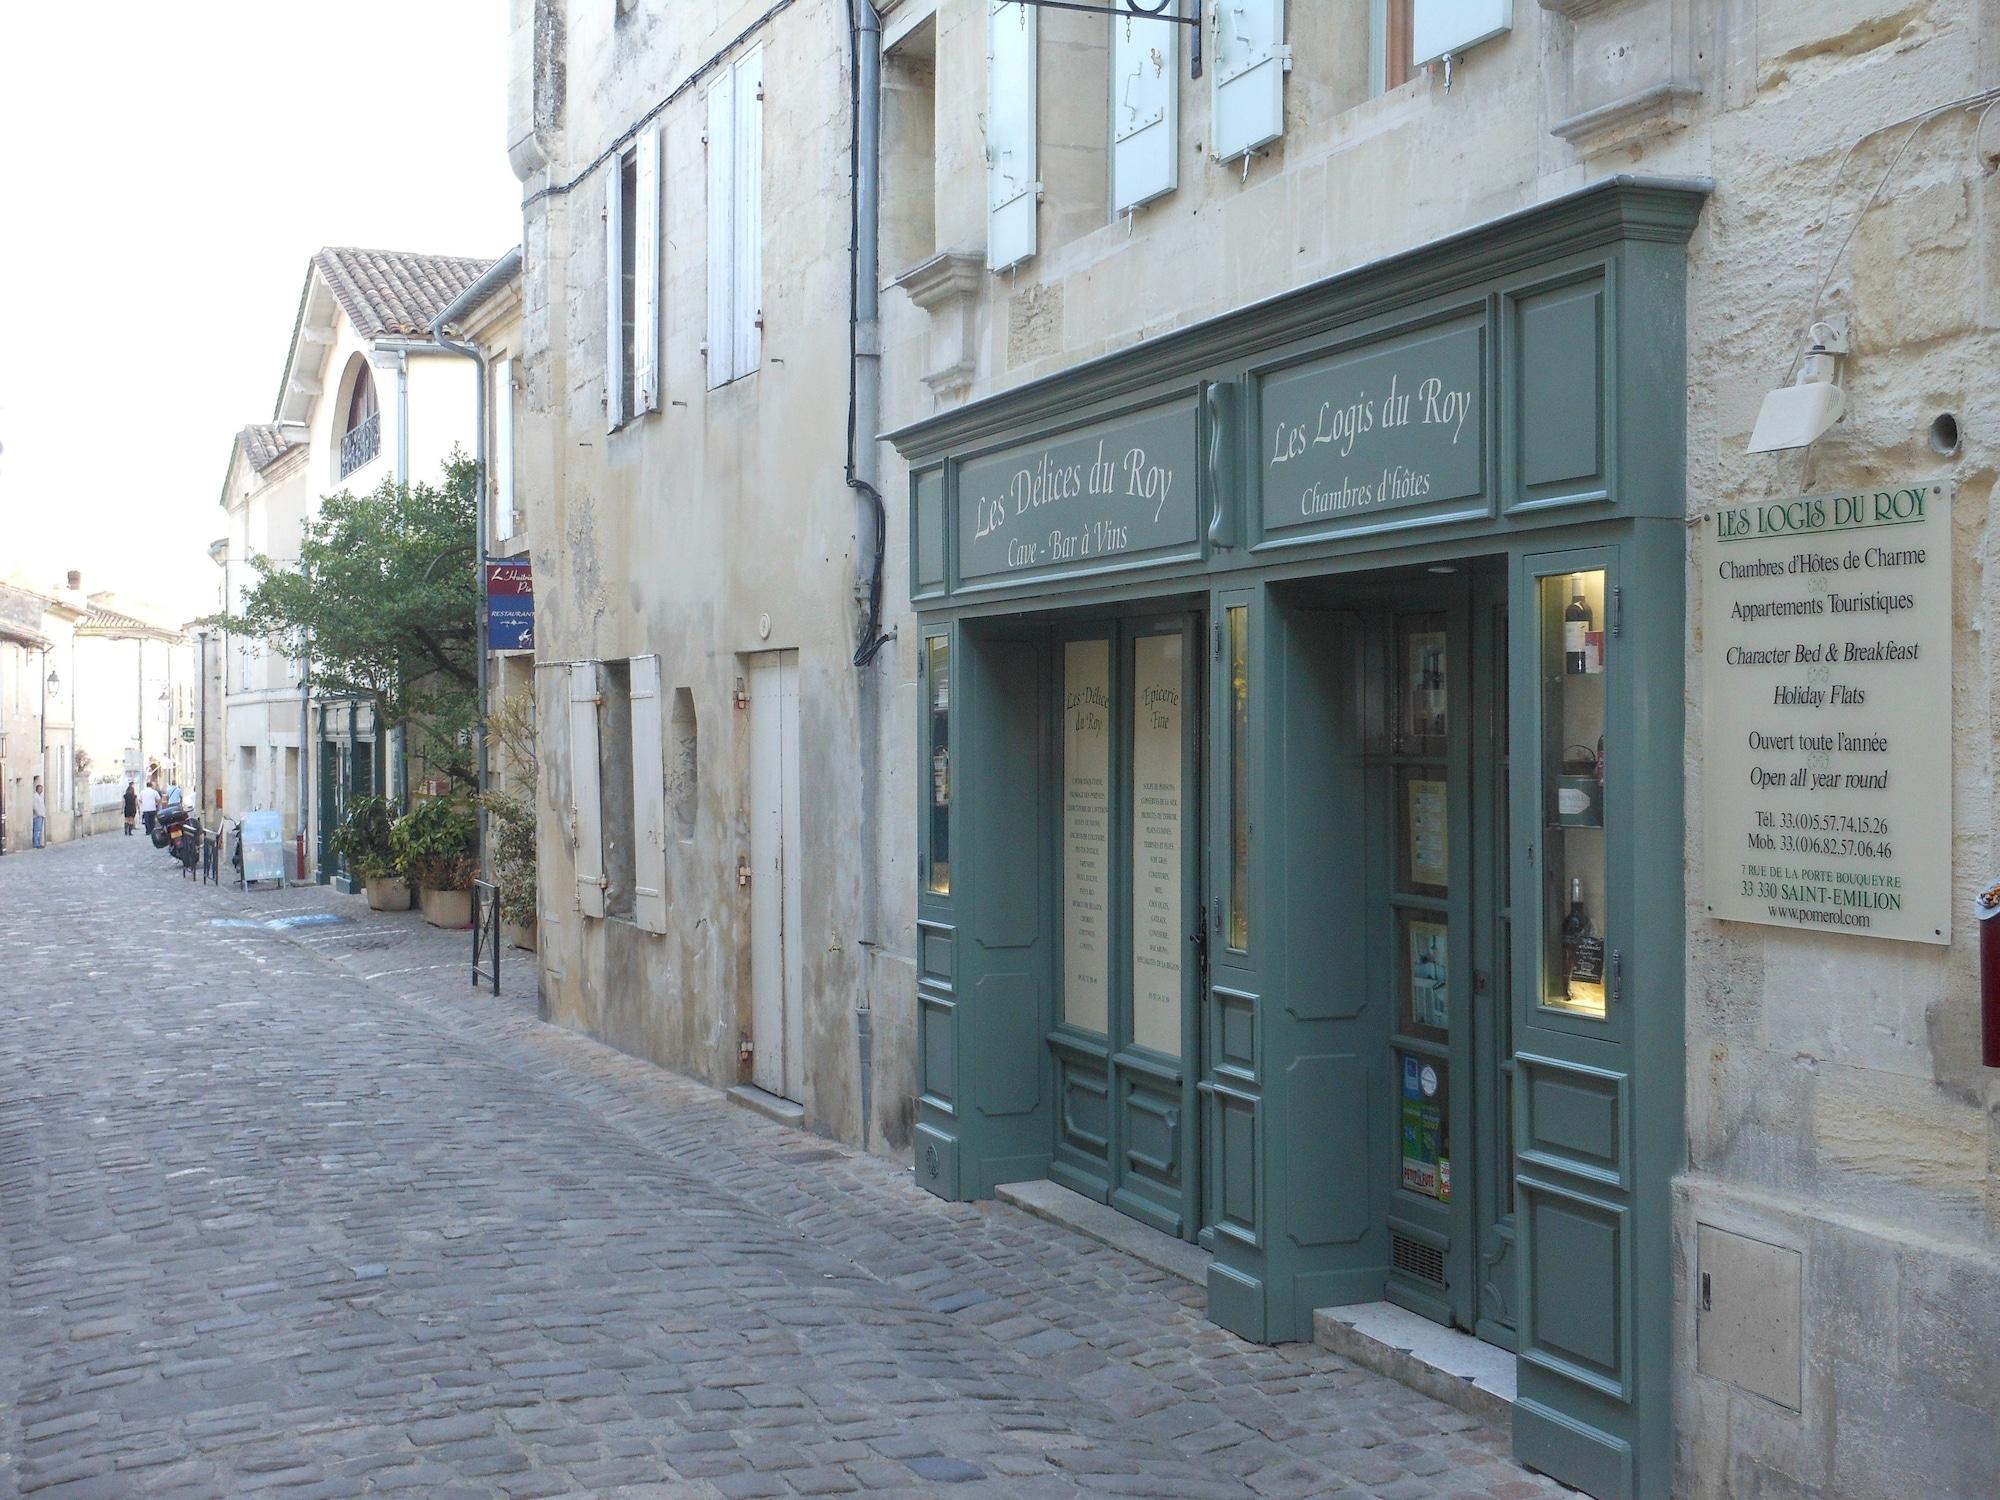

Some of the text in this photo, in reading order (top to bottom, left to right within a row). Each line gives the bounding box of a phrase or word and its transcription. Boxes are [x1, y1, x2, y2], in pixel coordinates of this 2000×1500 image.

[1270, 374, 1471, 469] Les Logis du Roy
[974, 439, 1173, 544] Les Délices du Roy
[1301, 465, 1431, 516] Chambres d'hôtes
[1717, 488, 1927, 537] LES LOGIS DU ROY
[1008, 538, 1037, 567] Cave
[1049, 529, 1077, 560] Bar
[1081, 523, 1090, 556] à
[1094, 520, 1128, 552] Vins
[1719, 547, 1926, 580] Chambres d'Hôtes de Charme
[1730, 591, 1914, 622] Appartements Touristiques
[1726, 640, 1920, 666] Character Bed & Breakfeast
[1773, 684, 1865, 708] Holiday Flats
[1075, 712, 1102, 738] du Roy
[1150, 711, 1169, 729] Fine
[1749, 731, 1888, 752] Ouvert toute l'année
[1750, 766, 1888, 791] Open all year round
[1755, 810, 1888, 835] Tél. 33.(0)5.57.74.15.26
[1748, 833, 1892, 859] Mob. 33.(0)6.82.57.06.46
[1748, 864, 1767, 877] RUE
[1769, 866, 1782, 878] DE
[1785, 868, 1798, 879] LA
[1801, 869, 1833, 883] PORTE
[1836, 872, 1902, 888] BOUQUEYRE
[1741, 880, 1902, 910] 33 330 SAINT-EMILION
[1768, 905, 1870, 928] www.pomerol.com
